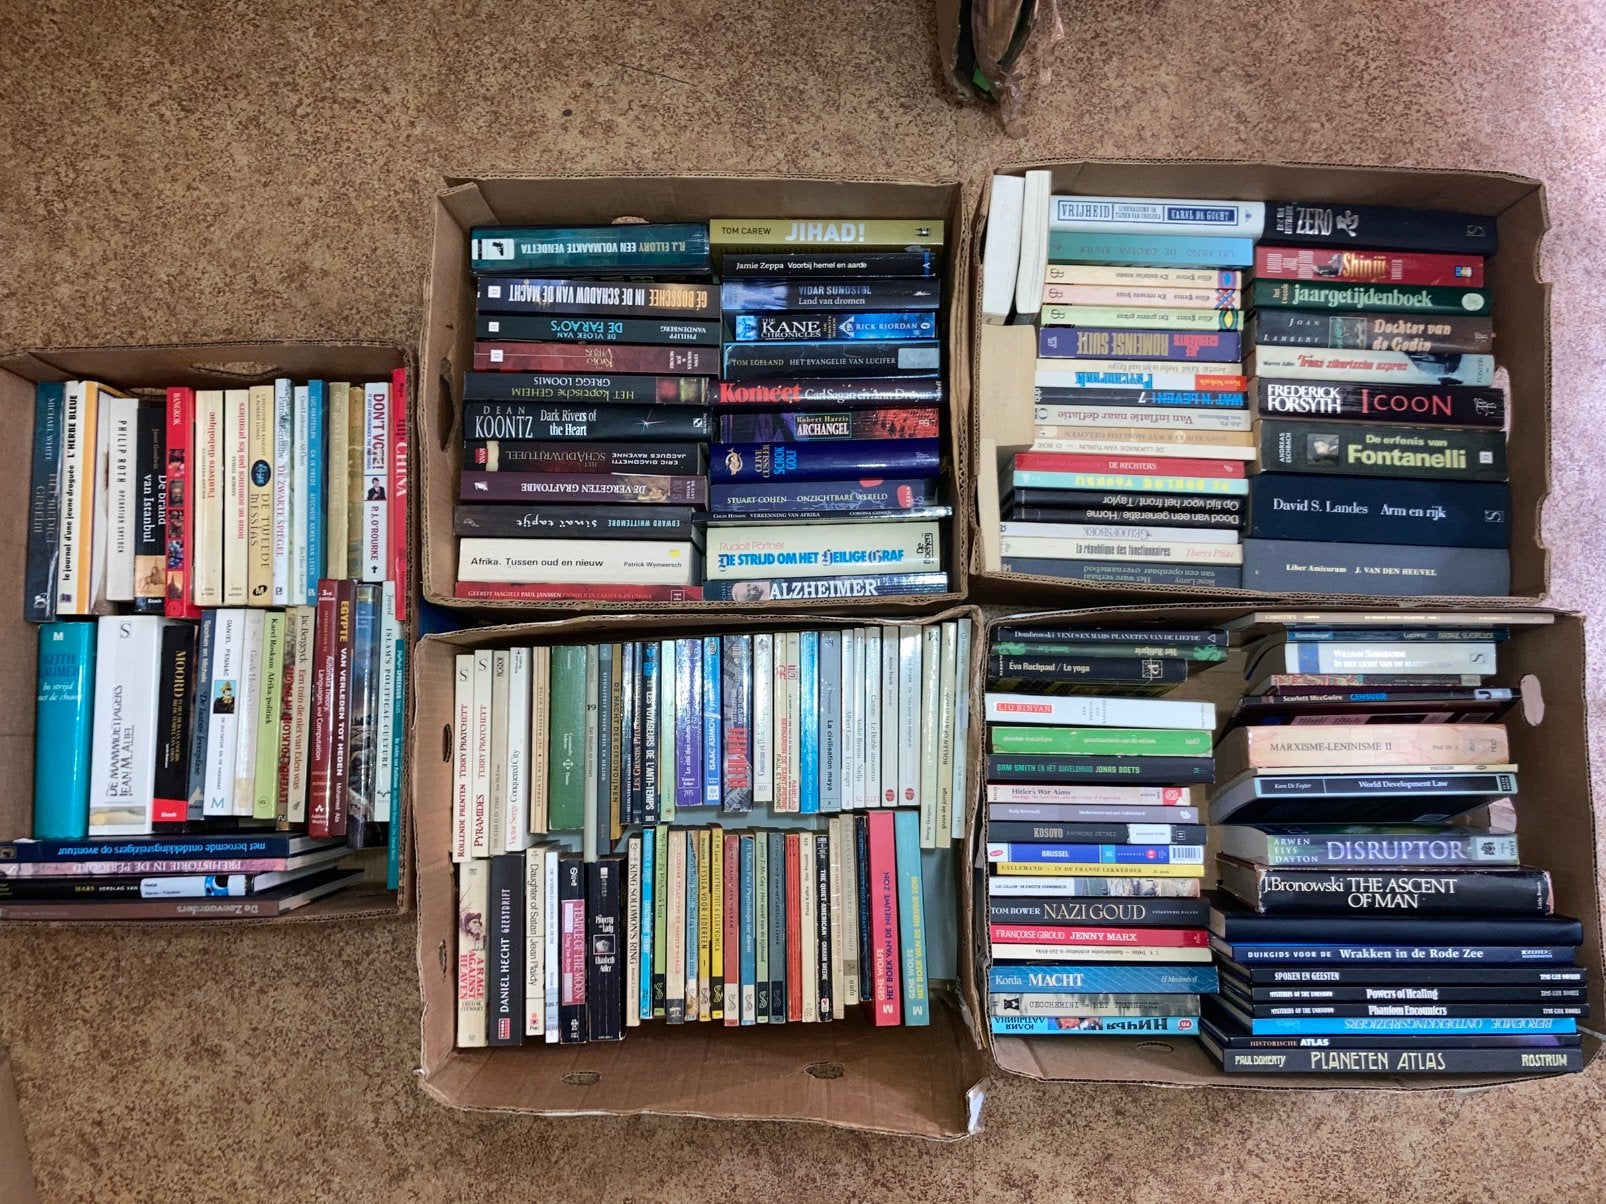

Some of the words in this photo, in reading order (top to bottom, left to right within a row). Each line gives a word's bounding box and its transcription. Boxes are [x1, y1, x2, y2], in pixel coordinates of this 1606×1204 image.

[1061, 204, 1110, 218] VRIJHEID
[1171, 210, 1194, 220] KAREL
[1195, 210, 1205, 220] DE
[1206, 211, 1230, 221] GUCHT
[1296, 207, 1333, 236] ZERO
[785, 223, 865, 242] JIHAD!
[788, 262, 812, 270] Voorbij
[1292, 284, 1432, 308] jaargetijdenboek
[1077, 332, 1108, 355] SUITE
[1111, 333, 1169, 356] ROMEINSE
[1372, 338, 1388, 351] de
[1391, 337, 1432, 352] Godin
[719, 383, 801, 403] Komeet
[1268, 384, 1341, 399] FREDERICK
[69, 395, 78, 420] BLEUE
[373, 393, 385, 427] DON'T
[483, 406, 526, 415] DEAN
[1268, 398, 1341, 413] FORSYTH
[540, 410, 559, 422] Dark
[562, 410, 587, 421] Rivers
[588, 409, 597, 421] of
[475, 416, 533, 438] KOONTZ
[550, 424, 563, 435] the
[565, 424, 587, 436] Heart
[797, 422, 849, 436] ARCHANGEL
[67, 422, 76, 458] L'HERBE
[118, 421, 127, 456] PHILIP
[1366, 435, 1381, 443] De
[1383, 436, 1424, 446] erfenis
[1428, 438, 1447, 447] van
[1348, 444, 1467, 468] Fontanelli
[117, 459, 126, 482] ROTH
[396, 442, 408, 497] CHINA
[521, 482, 579, 492] GRAFTOMBE
[582, 484, 631, 494] VERGETEN
[633, 485, 647, 494] DE
[261, 493, 270, 513] DE
[1273, 498, 1308, 511] David
[1311, 500, 1322, 512] S.
[1326, 501, 1368, 514] Landes
[143, 497, 154, 543] Istanbul
[251, 494, 260, 546] MESSIAS
[1381, 504, 1406, 516] Arm
[1409, 507, 1423, 517] en
[1426, 506, 1446, 521] rijk
[260, 516, 269, 570] TWEEDE
[471, 557, 502, 566] Afrika.
[505, 557, 538, 567] Tussen
[541, 558, 559, 567] oud
[576, 558, 604, 567] nieuw
[1308, 564, 1347, 572] Amicorum
[770, 580, 879, 600] ALZHEIMER
[340, 600, 349, 642] EGYPTE
[174, 650, 186, 698] MOORD
[338, 669, 346, 719] VERLEDEN
[460, 704, 468, 751] PRATCHETT
[479, 704, 487, 752] PRATCHETT
[1270, 742, 1383, 751] MARXISME-LENINISME
[1385, 742, 1392, 751] II
[336, 744, 344, 776] HEDEN
[478, 754, 486, 779] TERRY
[474, 794, 484, 847] PYRAMIDES
[1034, 828, 1064, 838] KOSOVO
[58, 847, 98, 856] avontuur
[101, 845, 112, 854] op
[114, 844, 203, 855] ontdekkingsreizigers
[205, 843, 247, 851] beroemde
[1042, 850, 1069, 858] BRUSSEL
[1326, 840, 1468, 860] DISRUPTOR
[527, 864, 538, 900] Daughter
[630, 864, 638, 886] KING
[1347, 878, 1383, 892] THE
[1386, 878, 1457, 894] ASCENT
[531, 902, 538, 910] of
[1348, 894, 1371, 908] OF
[1374, 894, 1418, 908] MAN
[630, 888, 638, 940] SOLOMON'S
[1043, 904, 1086, 920] NAZI
[1089, 905, 1145, 920] GOUD
[884, 928, 891, 940] DE
[1070, 932, 1104, 941] JENNY
[1106, 933, 1137, 941] MARX
[501, 938, 509, 973] HECHT
[630, 942, 638, 964] RING
[1340, 949, 1392, 958] Wrakken
[1396, 949, 1407, 958] in
[1412, 949, 1425, 958] de
[1430, 949, 1459, 958] Rode
[1463, 949, 1484, 958] Zee
[468, 951, 476, 999] AGAINST
[528, 960, 538, 986] Plaidy
[996, 975, 1022, 985] Korda
[1028, 974, 1084, 987] MACHT
[500, 975, 509, 1012] DANIEL
[1311, 1052, 1388, 1070] PLANETEN
[1397, 1053, 1446, 1070] ATLAS
[1522, 1055, 1568, 1066] ROSTRUM
